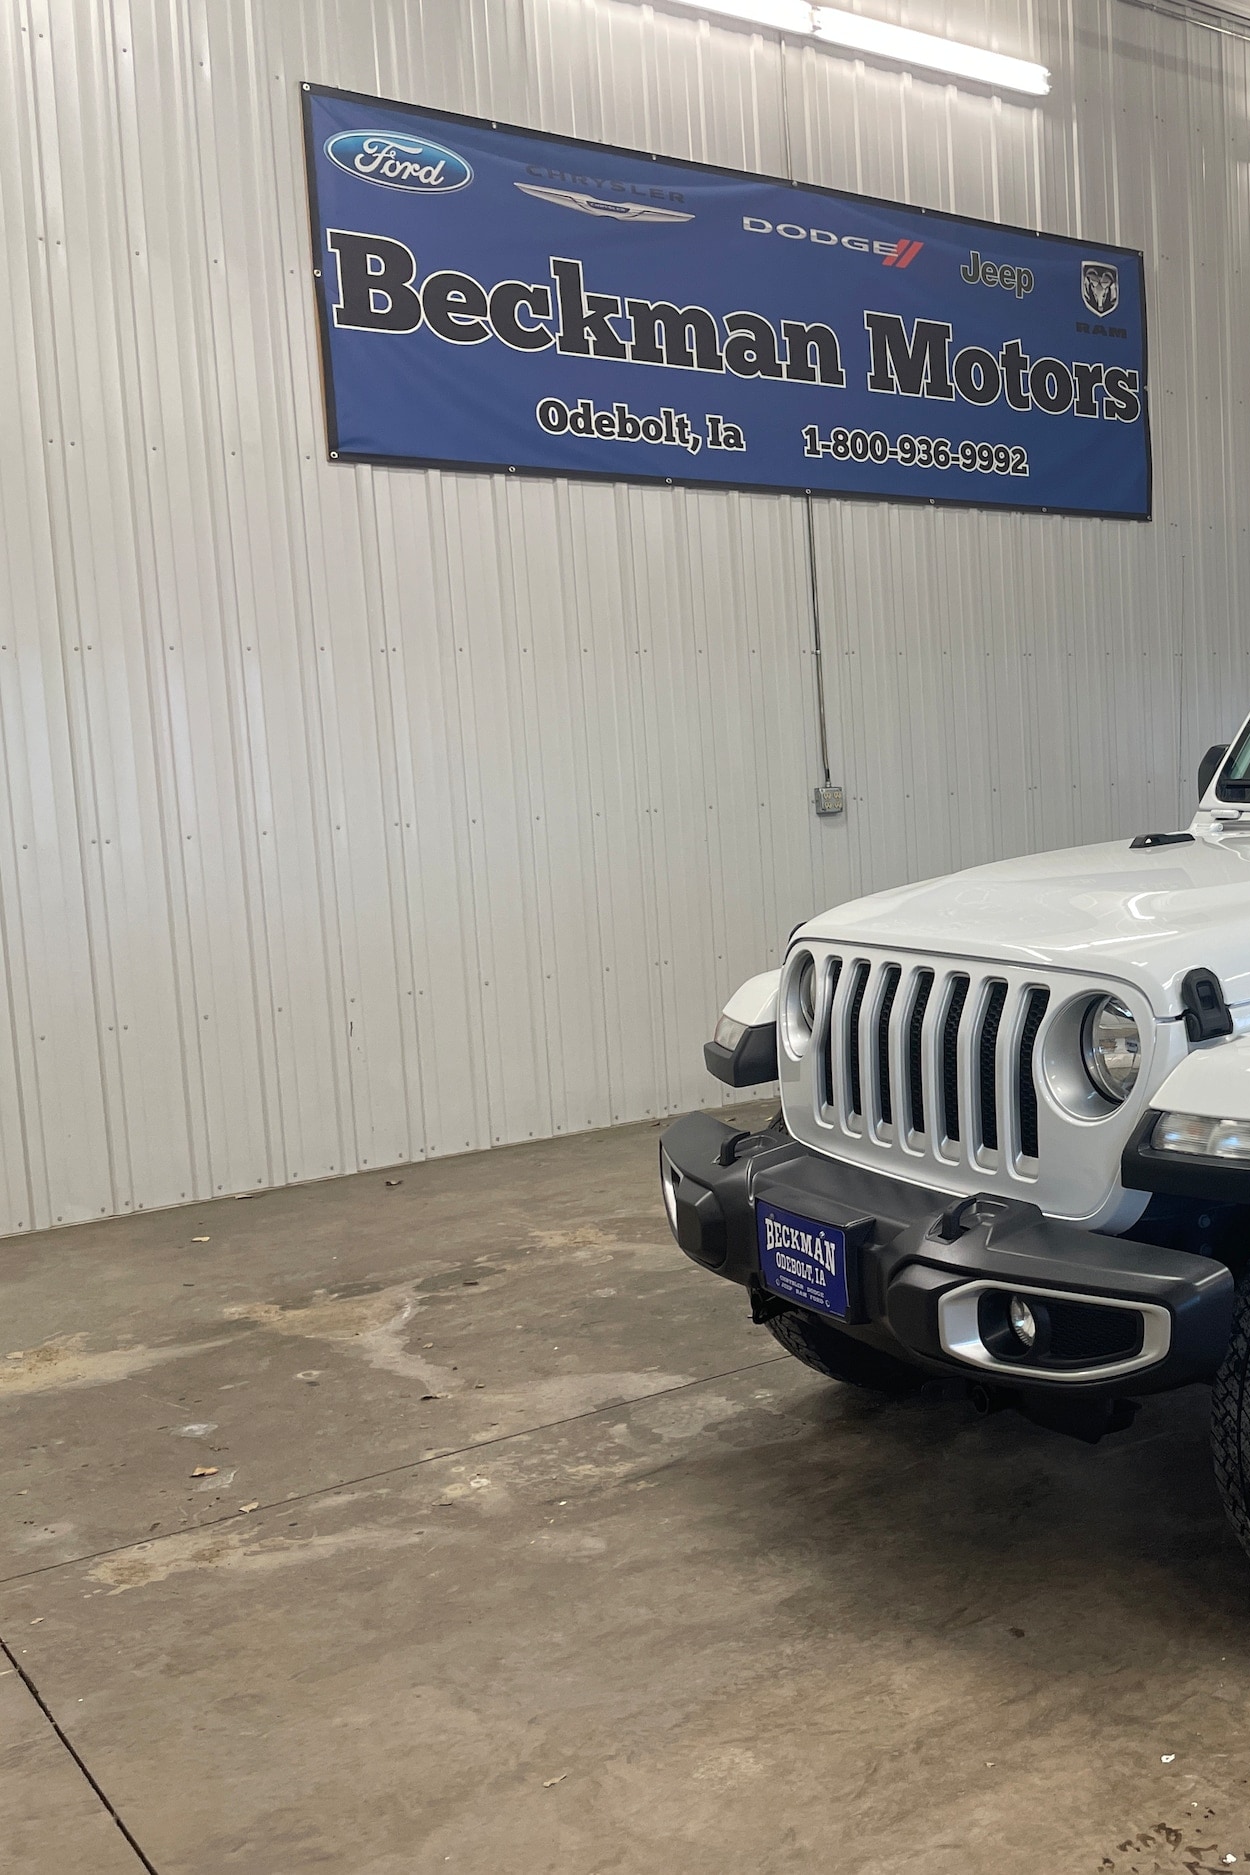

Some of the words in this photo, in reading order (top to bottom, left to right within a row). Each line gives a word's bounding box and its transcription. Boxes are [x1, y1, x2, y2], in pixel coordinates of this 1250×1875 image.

[354, 138, 446, 187] Ford
[525, 163, 686, 204] CHRYSLER
[742, 216, 900, 258] DODGE
[960, 250, 1034, 299] Jeep
[326, 228, 847, 388] Beckman
[863, 309, 1142, 424] Motors
[1075, 321, 1128, 339] RAM
[536, 397, 702, 456] Odebolt,
[705, 414, 747, 452] Ia
[801, 424, 1031, 477] 1-800-936-9992
[764, 1217, 836, 1277] BECKMAN
[775, 1251, 815, 1285] ODEBOLT,
[815, 1267, 827, 1287] IA
[795, 1288, 808, 1298] RAM
